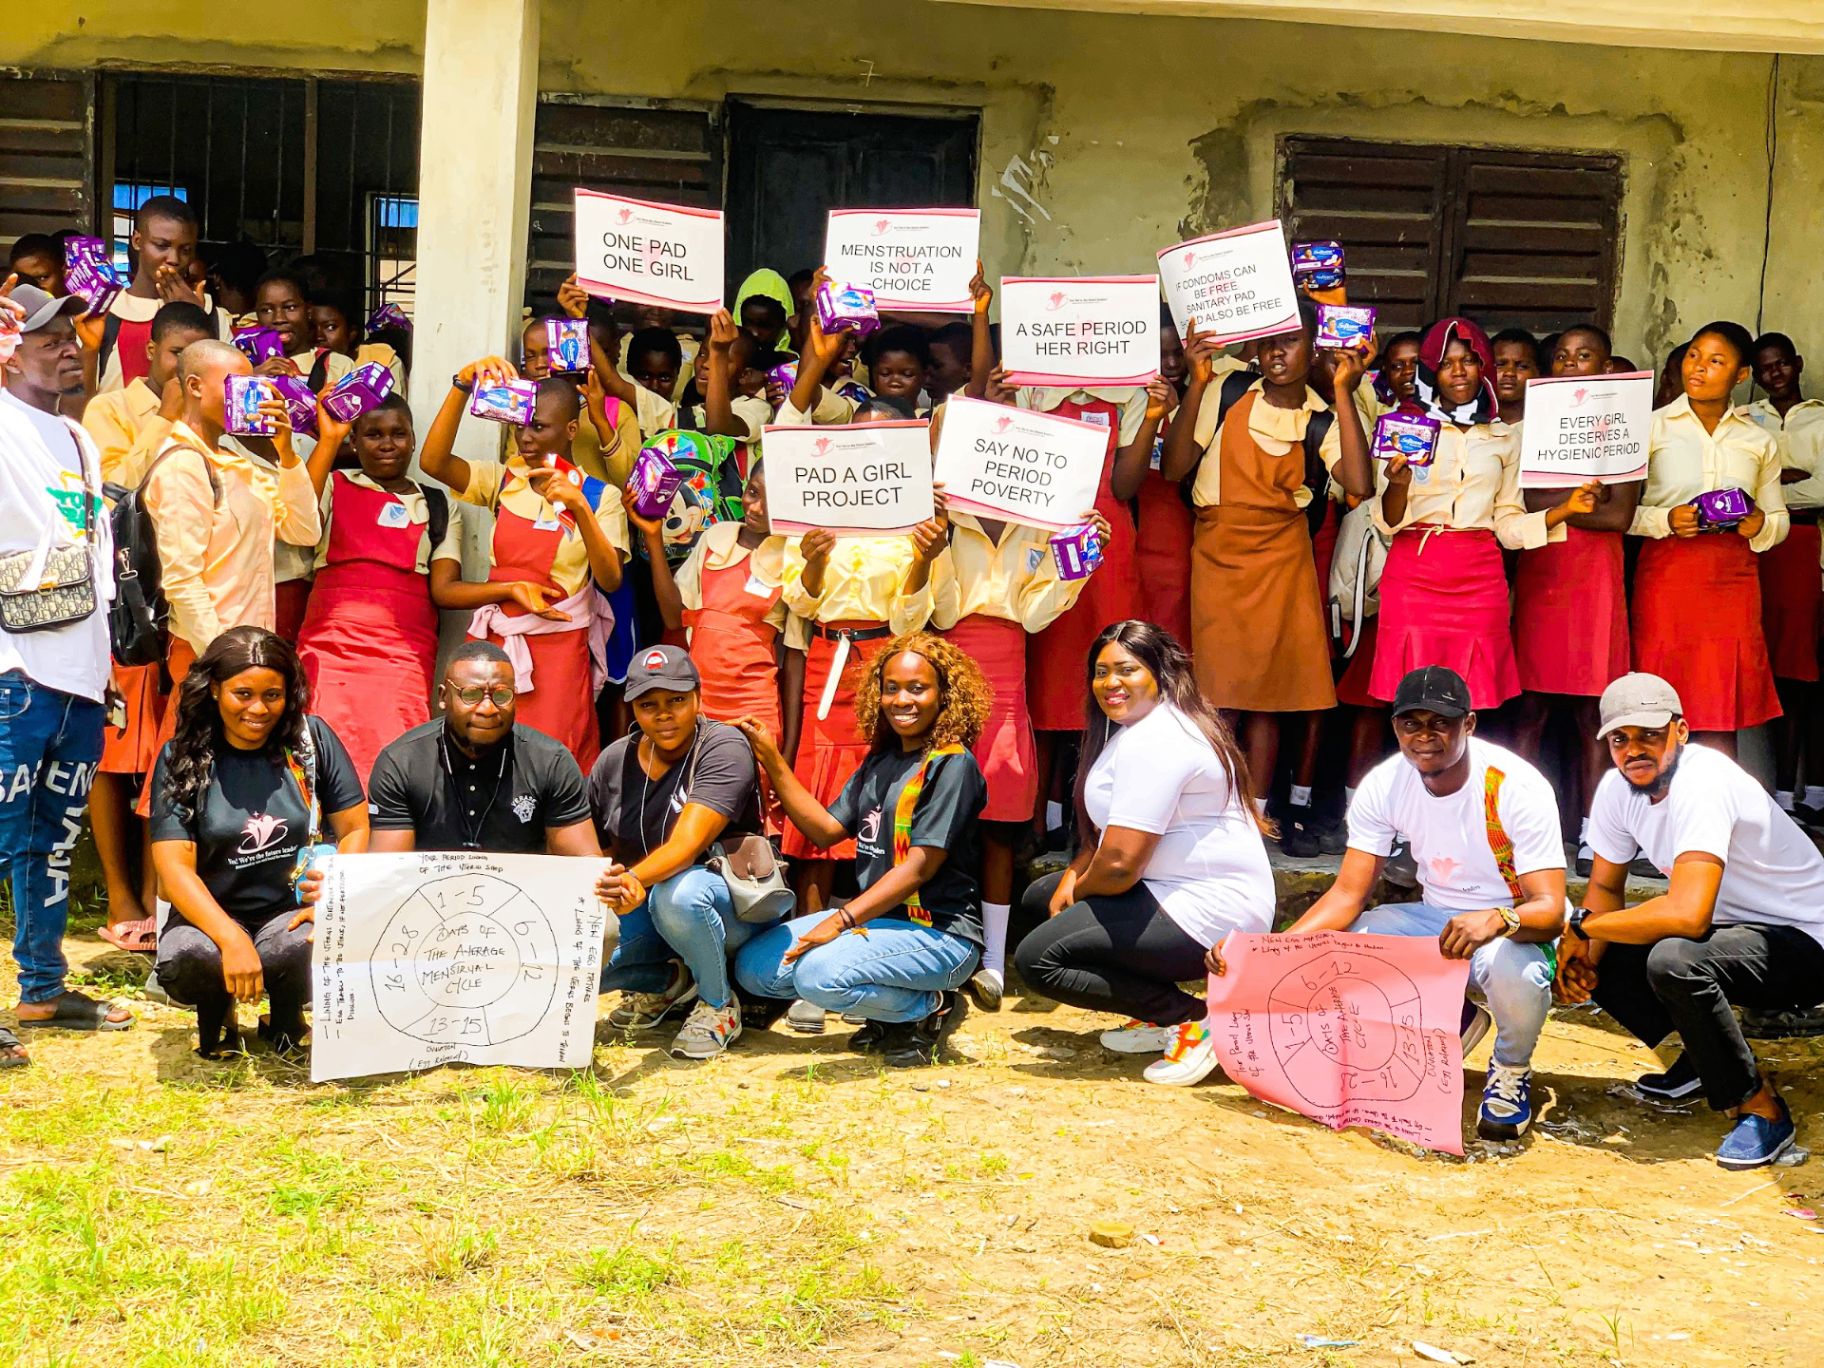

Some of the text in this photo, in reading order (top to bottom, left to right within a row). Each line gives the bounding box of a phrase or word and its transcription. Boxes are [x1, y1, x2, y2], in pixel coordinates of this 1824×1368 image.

[603, 232, 687, 259] ONE PAD
[841, 244, 962, 258] MENSTRUATION
[603, 253, 694, 281] ONE GIRL
[870, 261, 934, 274] IS NOT A
[872, 278, 931, 291] CHOICE
[1175, 264, 1257, 292] IF CONDOMS CAN
[1194, 281, 1238, 299] BE FREE
[1186, 290, 1256, 314] SANITARY PAD
[1205, 308, 1234, 323] ALSO
[1236, 305, 1250, 316] BE
[1252, 297, 1283, 313] FREE
[1016, 320, 1147, 336] A SAFE PERIOD
[1036, 340, 1130, 355] HER RIGHT
[1560, 412, 1627, 429] EVERY GIRL
[1559, 428, 1630, 445] DESERVES A
[974, 438, 1067, 469] SAY NO TO
[1537, 442, 1640, 461] HYGIENIC PERIOD
[795, 462, 912, 484] PAD A GIRL
[985, 460, 1052, 486] PERIOD
[802, 486, 903, 507] PROJECT
[971, 478, 1055, 507] POVERTY
[419, 866, 429, 874] OF
[479, 924, 497, 939] OF
[587, 914, 602, 938] NEW
[1261, 935, 1282, 944] NEW
[423, 944, 506, 962] THE AVERAGE
[587, 946, 597, 966] EGG
[322, 956, 331, 974] THE
[336, 967, 343, 978] TO
[323, 977, 331, 987] OF
[445, 977, 482, 994] CYCLE
[1339, 1024, 1351, 1044] THE
[1348, 1001, 1366, 1049] CYCLE
